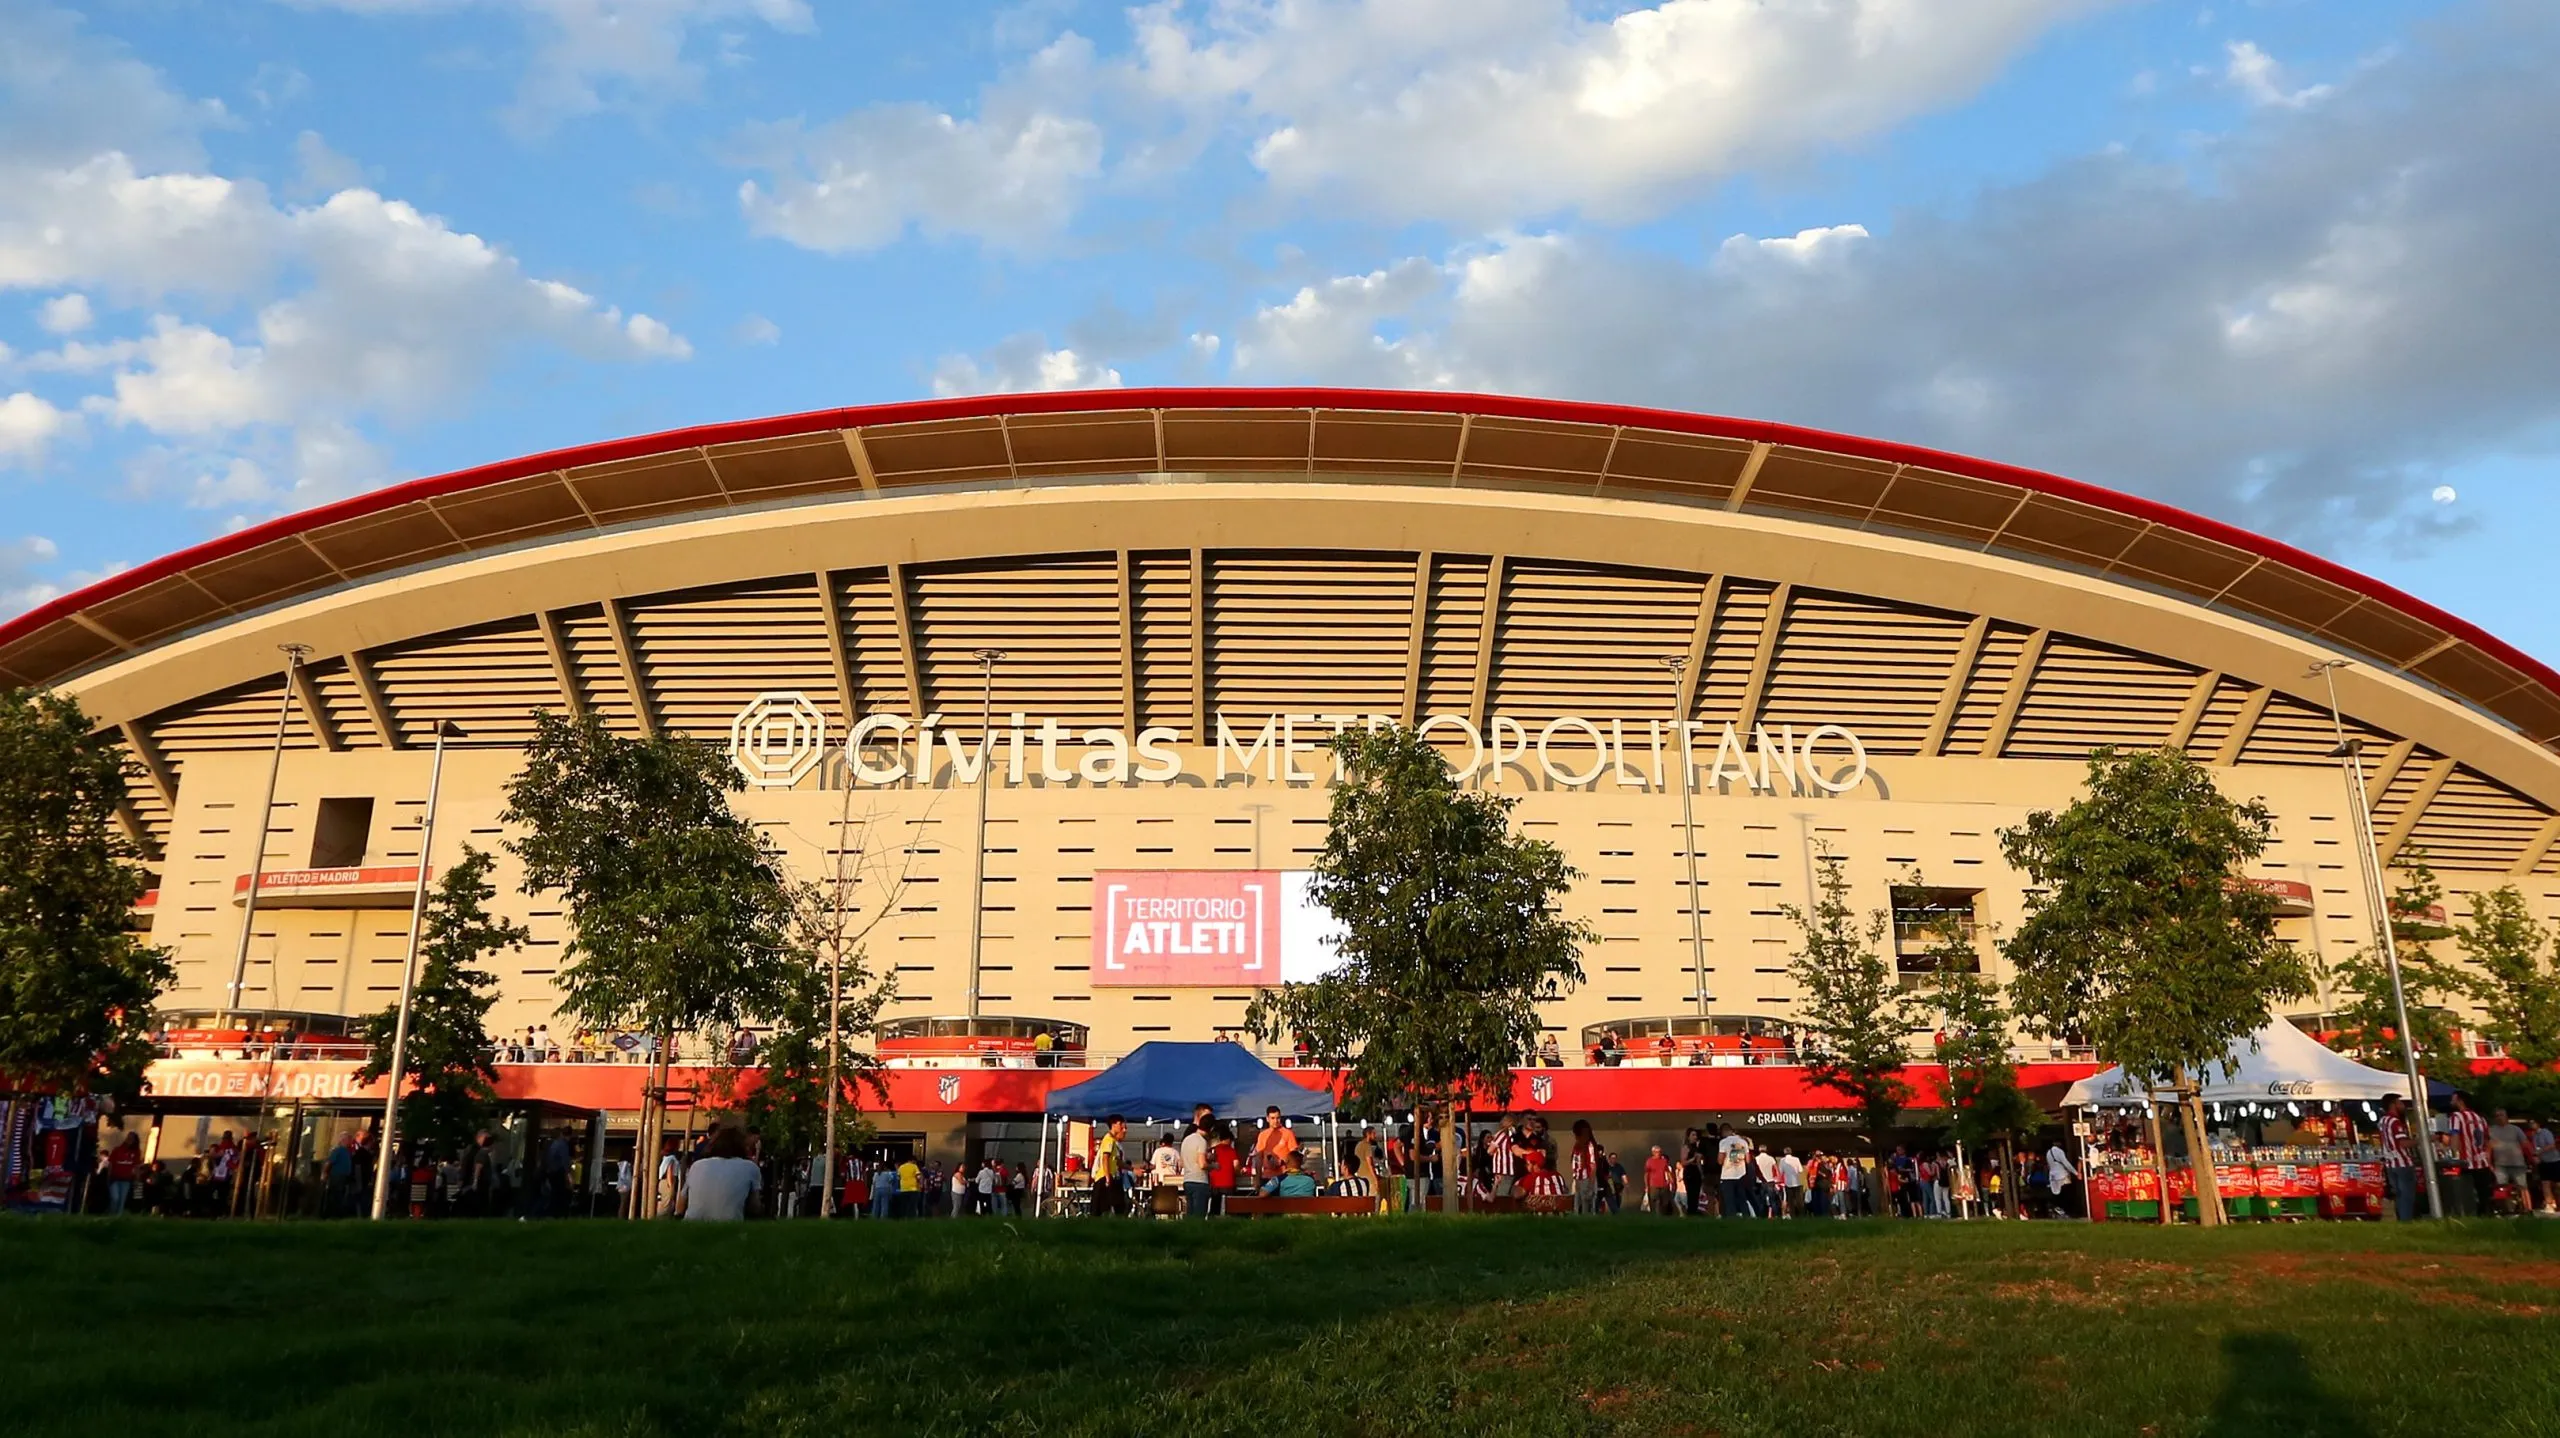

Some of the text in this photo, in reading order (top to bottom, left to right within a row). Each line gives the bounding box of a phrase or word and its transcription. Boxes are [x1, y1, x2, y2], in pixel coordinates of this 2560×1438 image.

[848, 712, 1183, 786] Cívitas
[266, 872, 310, 884] ATLÉTICO
[319, 871, 360, 883] MADRID
[1124, 898, 1245, 919] TERRITORIO
[1123, 921, 1245, 954] ATLETI
[226, 1075, 247, 1093] DE
[249, 1071, 359, 1098] MADRID
[2268, 1079, 2314, 1096] Coca-Cola
[1757, 1112, 1802, 1127] GRADONA
